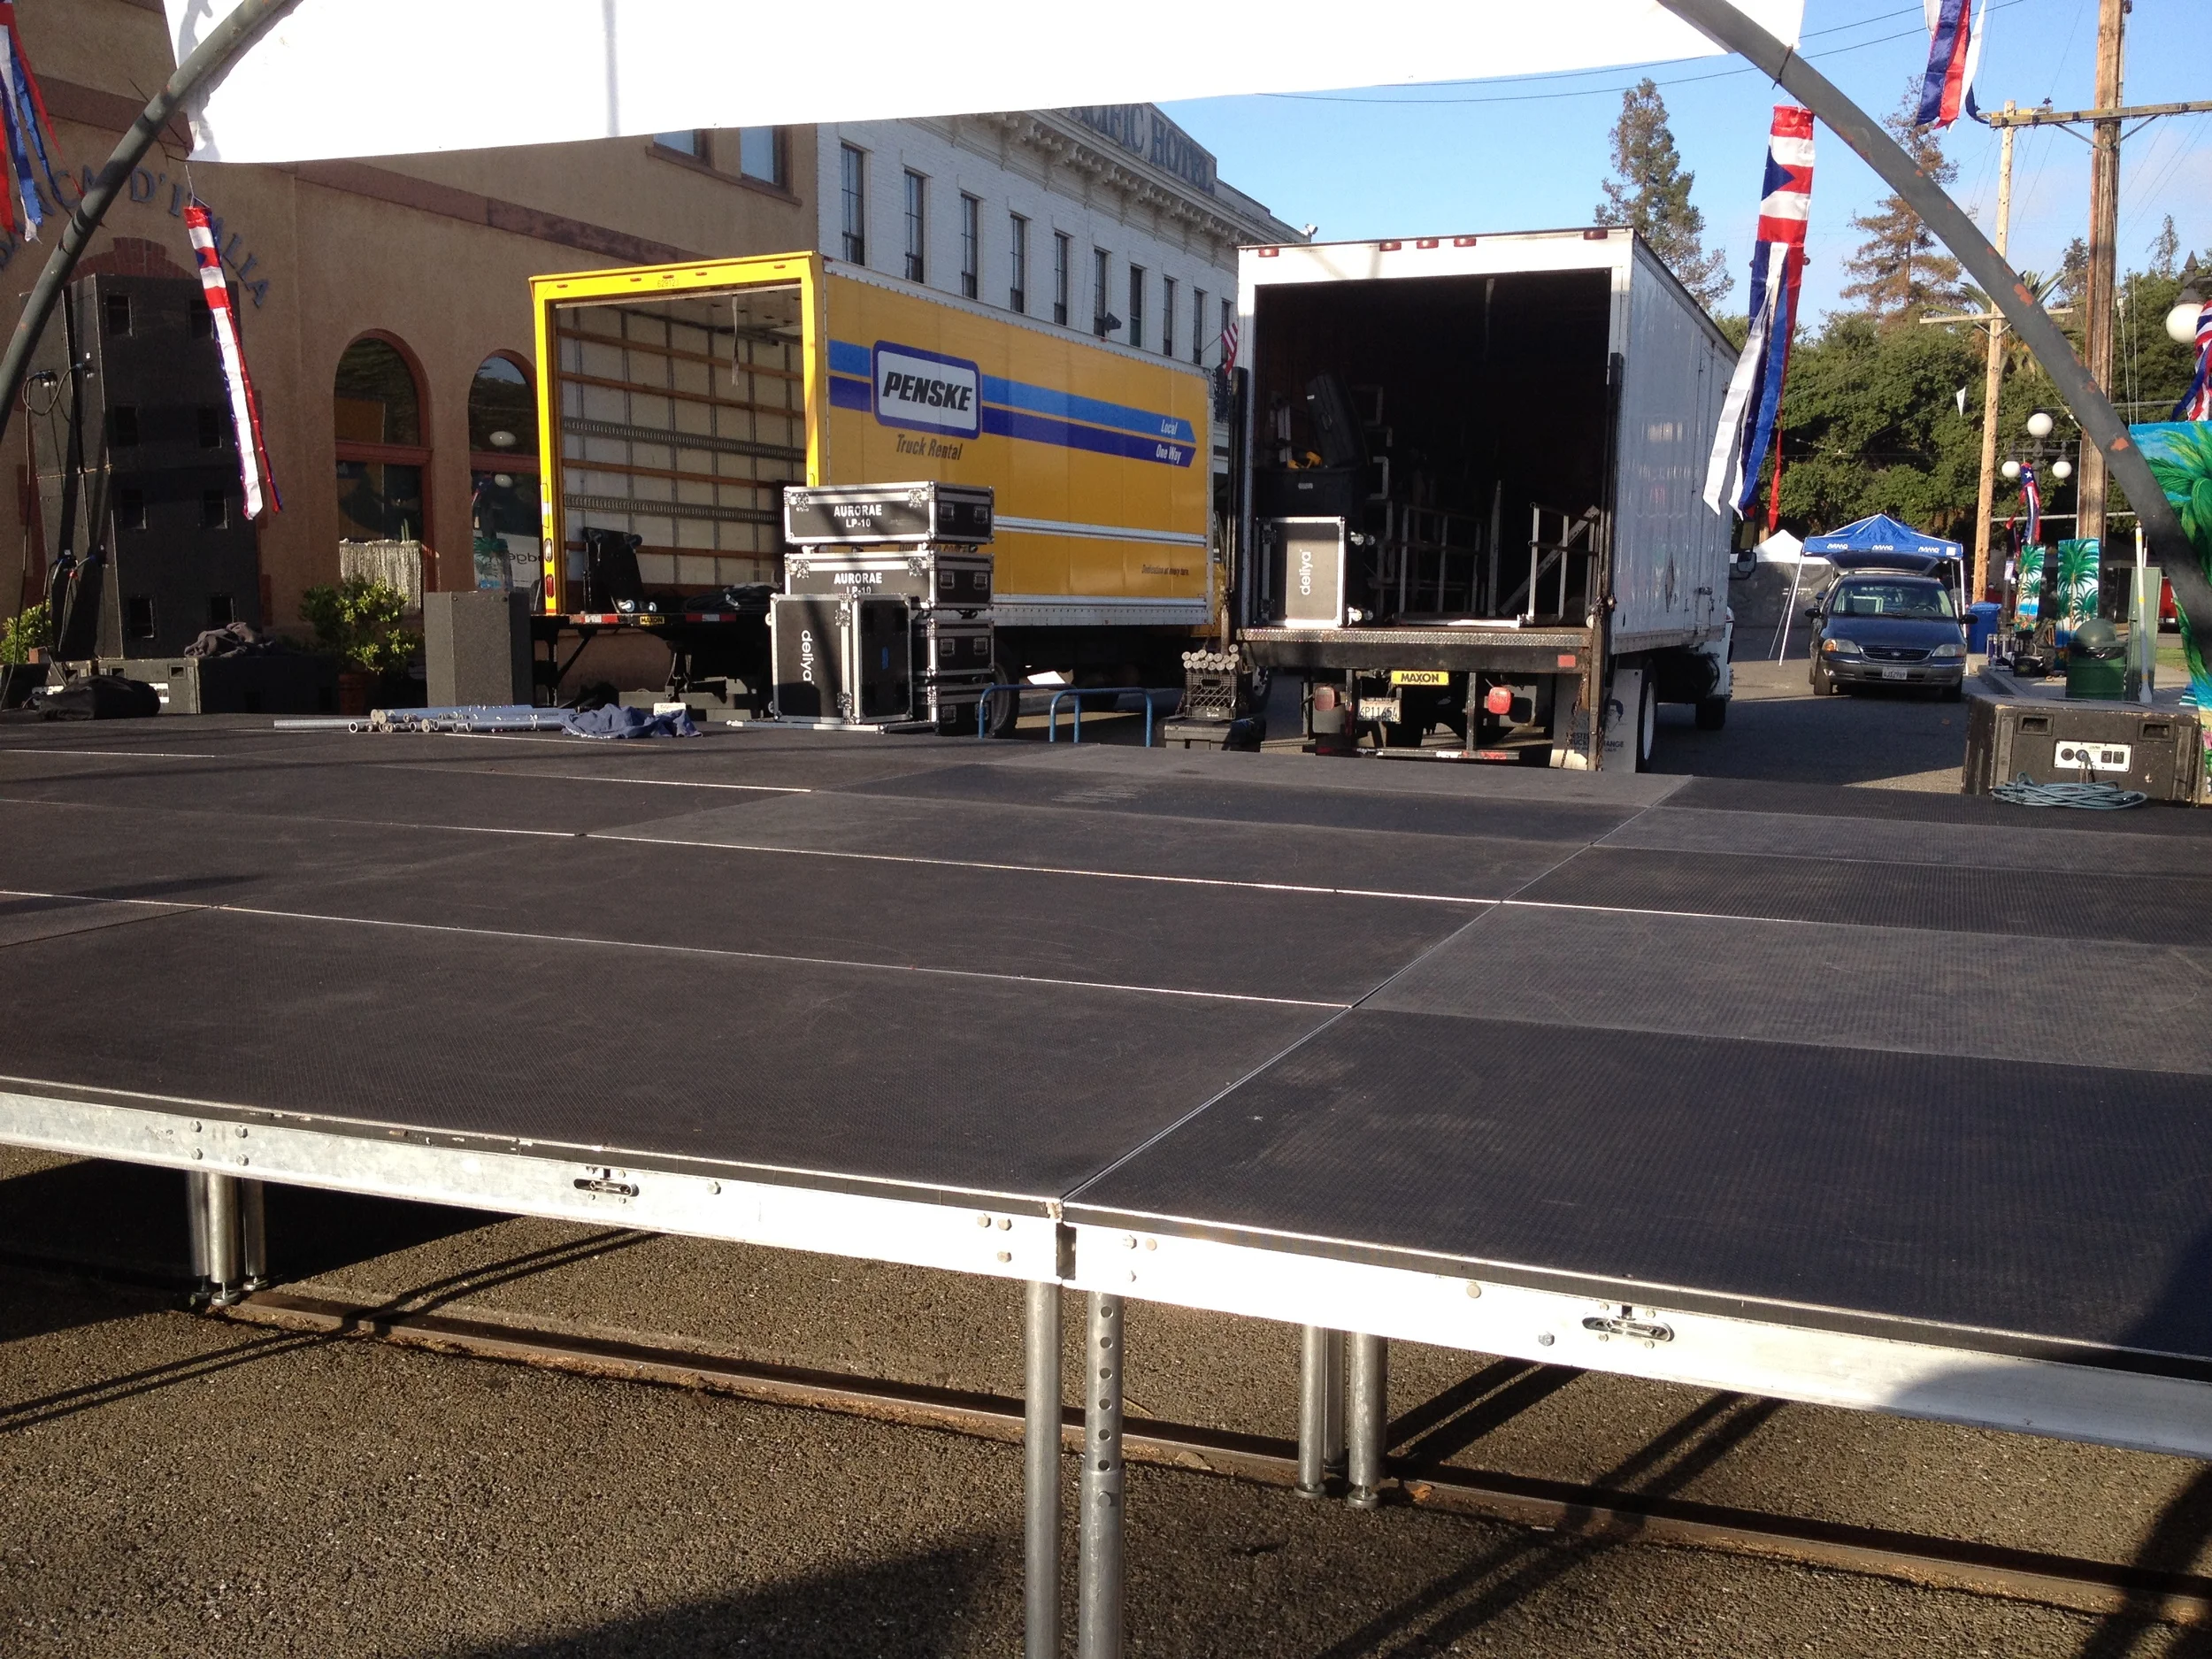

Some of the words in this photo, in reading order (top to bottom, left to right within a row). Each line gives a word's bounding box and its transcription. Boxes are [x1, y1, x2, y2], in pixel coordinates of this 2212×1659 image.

[1150, 112, 1215, 196] HOTEL
[882, 371, 972, 411] PENSKE
[1161, 419, 1179, 434] Local
[896, 434, 926, 456] Truck
[928, 439, 963, 460] Rental
[1156, 443, 1168, 459] One
[1169, 446, 1182, 465] Way
[833, 504, 882, 517] AURORAE
[846, 518, 872, 528] LP-10
[833, 572, 882, 585] AURORAE
[1299, 551, 1314, 595] deliya
[846, 586, 872, 595] LP-10
[800, 629, 814, 682] deliya
[1400, 672, 1440, 683] MAXON
